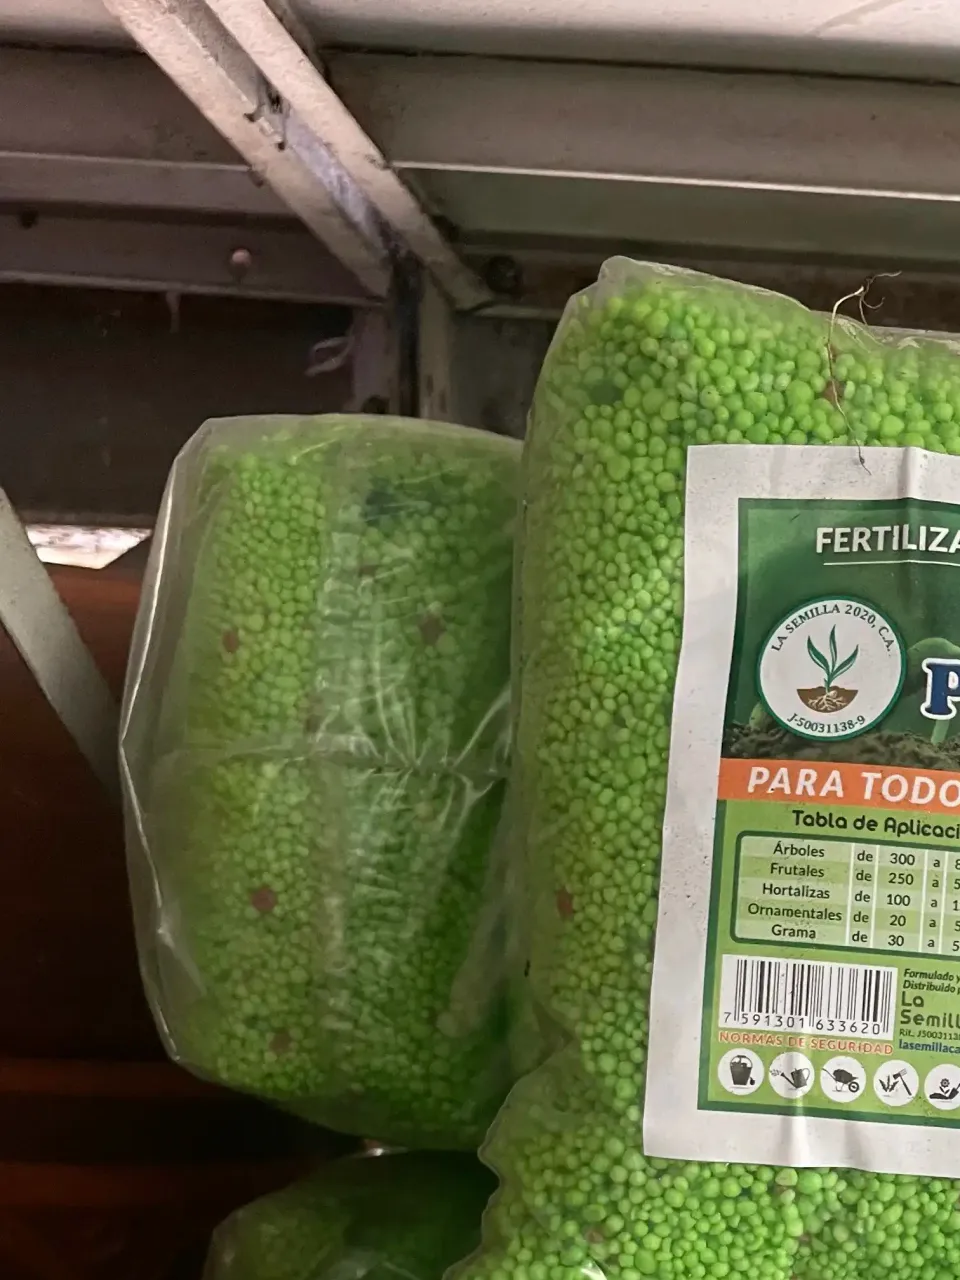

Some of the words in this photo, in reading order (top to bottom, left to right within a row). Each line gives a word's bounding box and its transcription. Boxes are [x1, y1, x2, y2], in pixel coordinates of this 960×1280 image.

[772, 635, 787, 651] LA
[785, 604, 840, 634] SEMILLA
[845, 604, 876, 628] 2020,
[787, 713, 866, 734] J-50031138-9
[748, 766, 844, 797] PARA
[792, 810, 847, 830] Tabla
[853, 815, 878, 832] de
[773, 841, 825, 857] Árboles
[857, 850, 873, 862] de
[890, 853, 915, 866] 300
[933, 859, 940, 867] a
[770, 863, 825, 878] Frutales
[856, 870, 872, 881] de
[888, 872, 914, 885] 250
[932, 880, 939, 888] a
[762, 883, 830, 899] Hortalizas
[854, 890, 871, 902] de
[887, 894, 911, 906] 100
[931, 899, 938, 908] a
[748, 903, 842, 921] Ornamentales
[853, 911, 869, 923] de
[889, 914, 906, 927] 20
[929, 920, 936, 928] a
[771, 924, 816, 938] Grama
[852, 931, 868, 942] de
[888, 934, 904, 947] 30
[927, 939, 935, 947] a
[904, 968, 954, 981] Formulado
[903, 980, 956, 993] Distribuido
[901, 991, 925, 1008] La
[724, 1012, 732, 1023] 7
[742, 1013, 805, 1029] 591301
[816, 1019, 880, 1035] 633620
[719, 1032, 782, 1046] NORMAS
[788, 1036, 805, 1048] DE
[811, 1039, 893, 1055] SEGURIDAD
